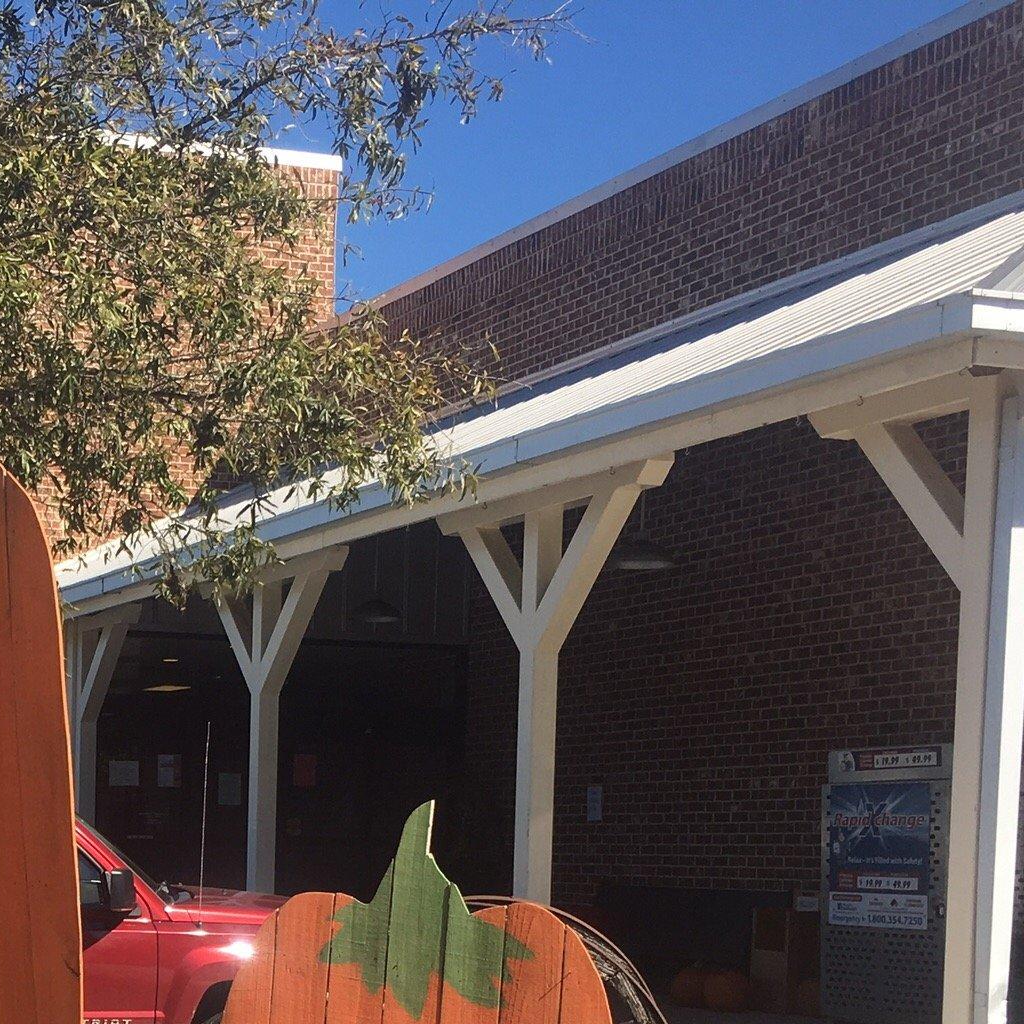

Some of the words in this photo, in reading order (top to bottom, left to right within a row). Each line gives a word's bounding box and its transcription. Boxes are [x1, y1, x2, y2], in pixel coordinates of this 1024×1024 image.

[882, 756, 900, 766] 19.99
[912, 754, 932, 764] 49.99
[891, 857, 902, 865] with
[865, 879, 883, 887] 19.99
[892, 880, 911, 888] 49.99
